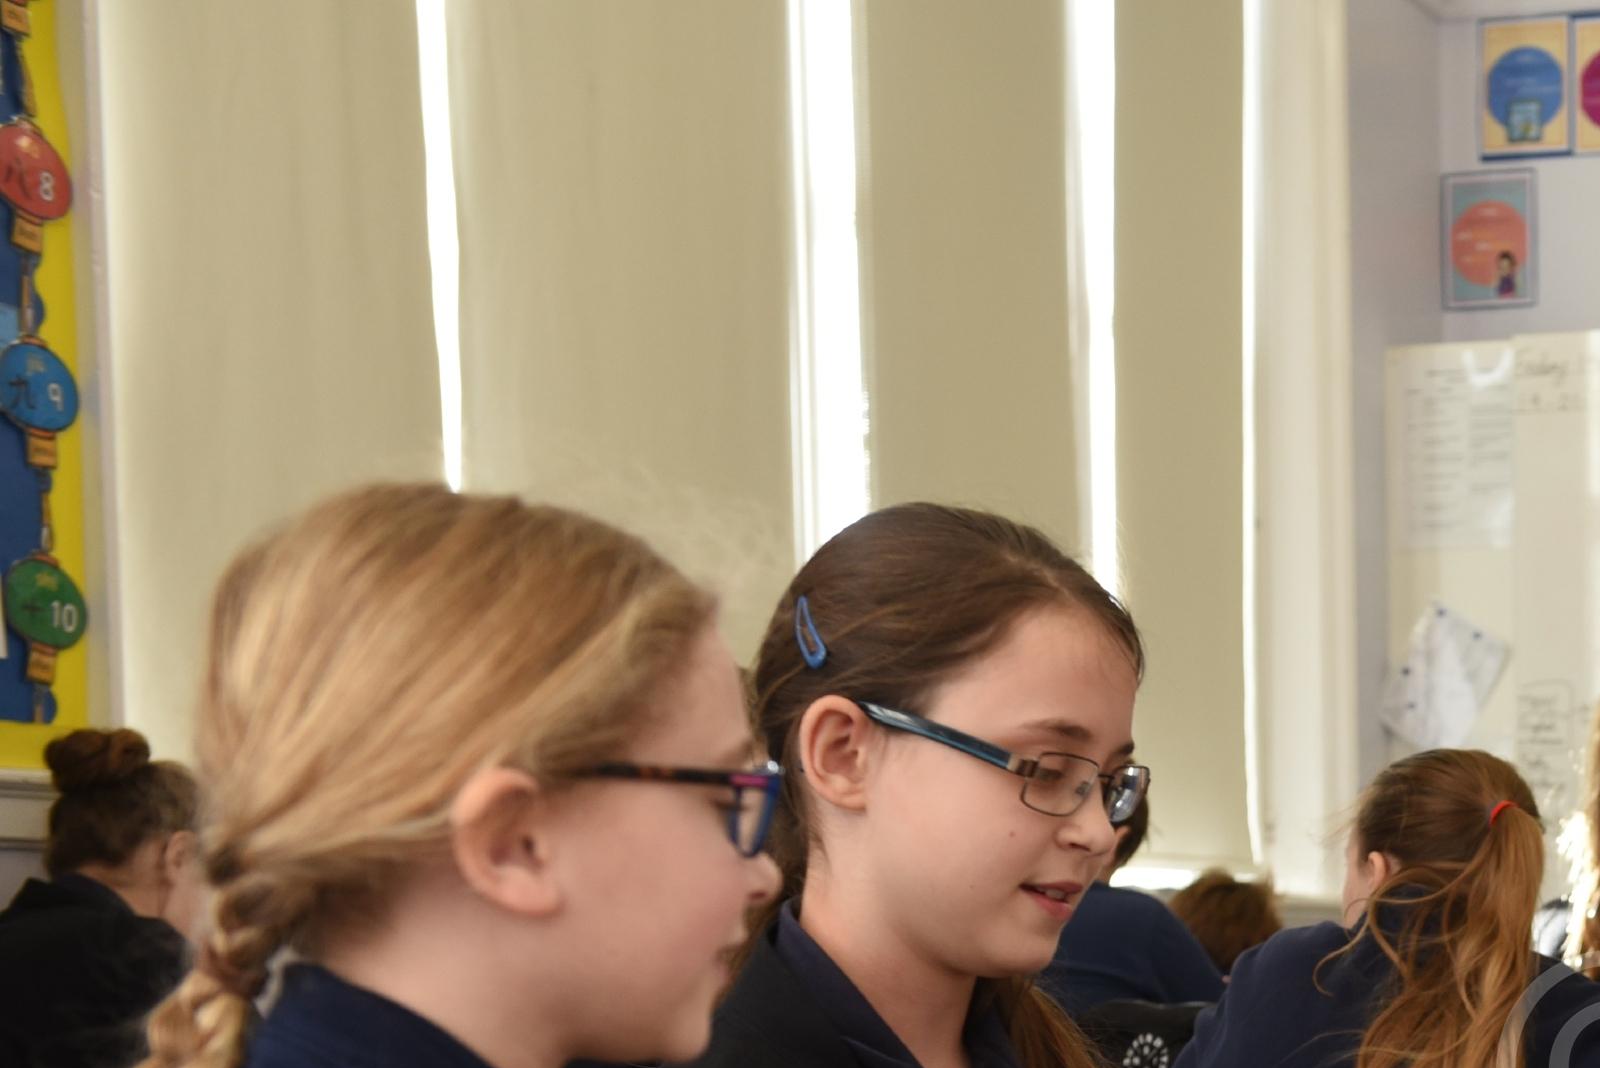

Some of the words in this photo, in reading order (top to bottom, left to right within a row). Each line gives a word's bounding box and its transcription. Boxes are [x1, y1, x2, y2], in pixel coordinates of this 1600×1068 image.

[40, 170, 55, 201] 8
[47, 383, 64, 411] 9
[51, 600, 78, 633] 10
